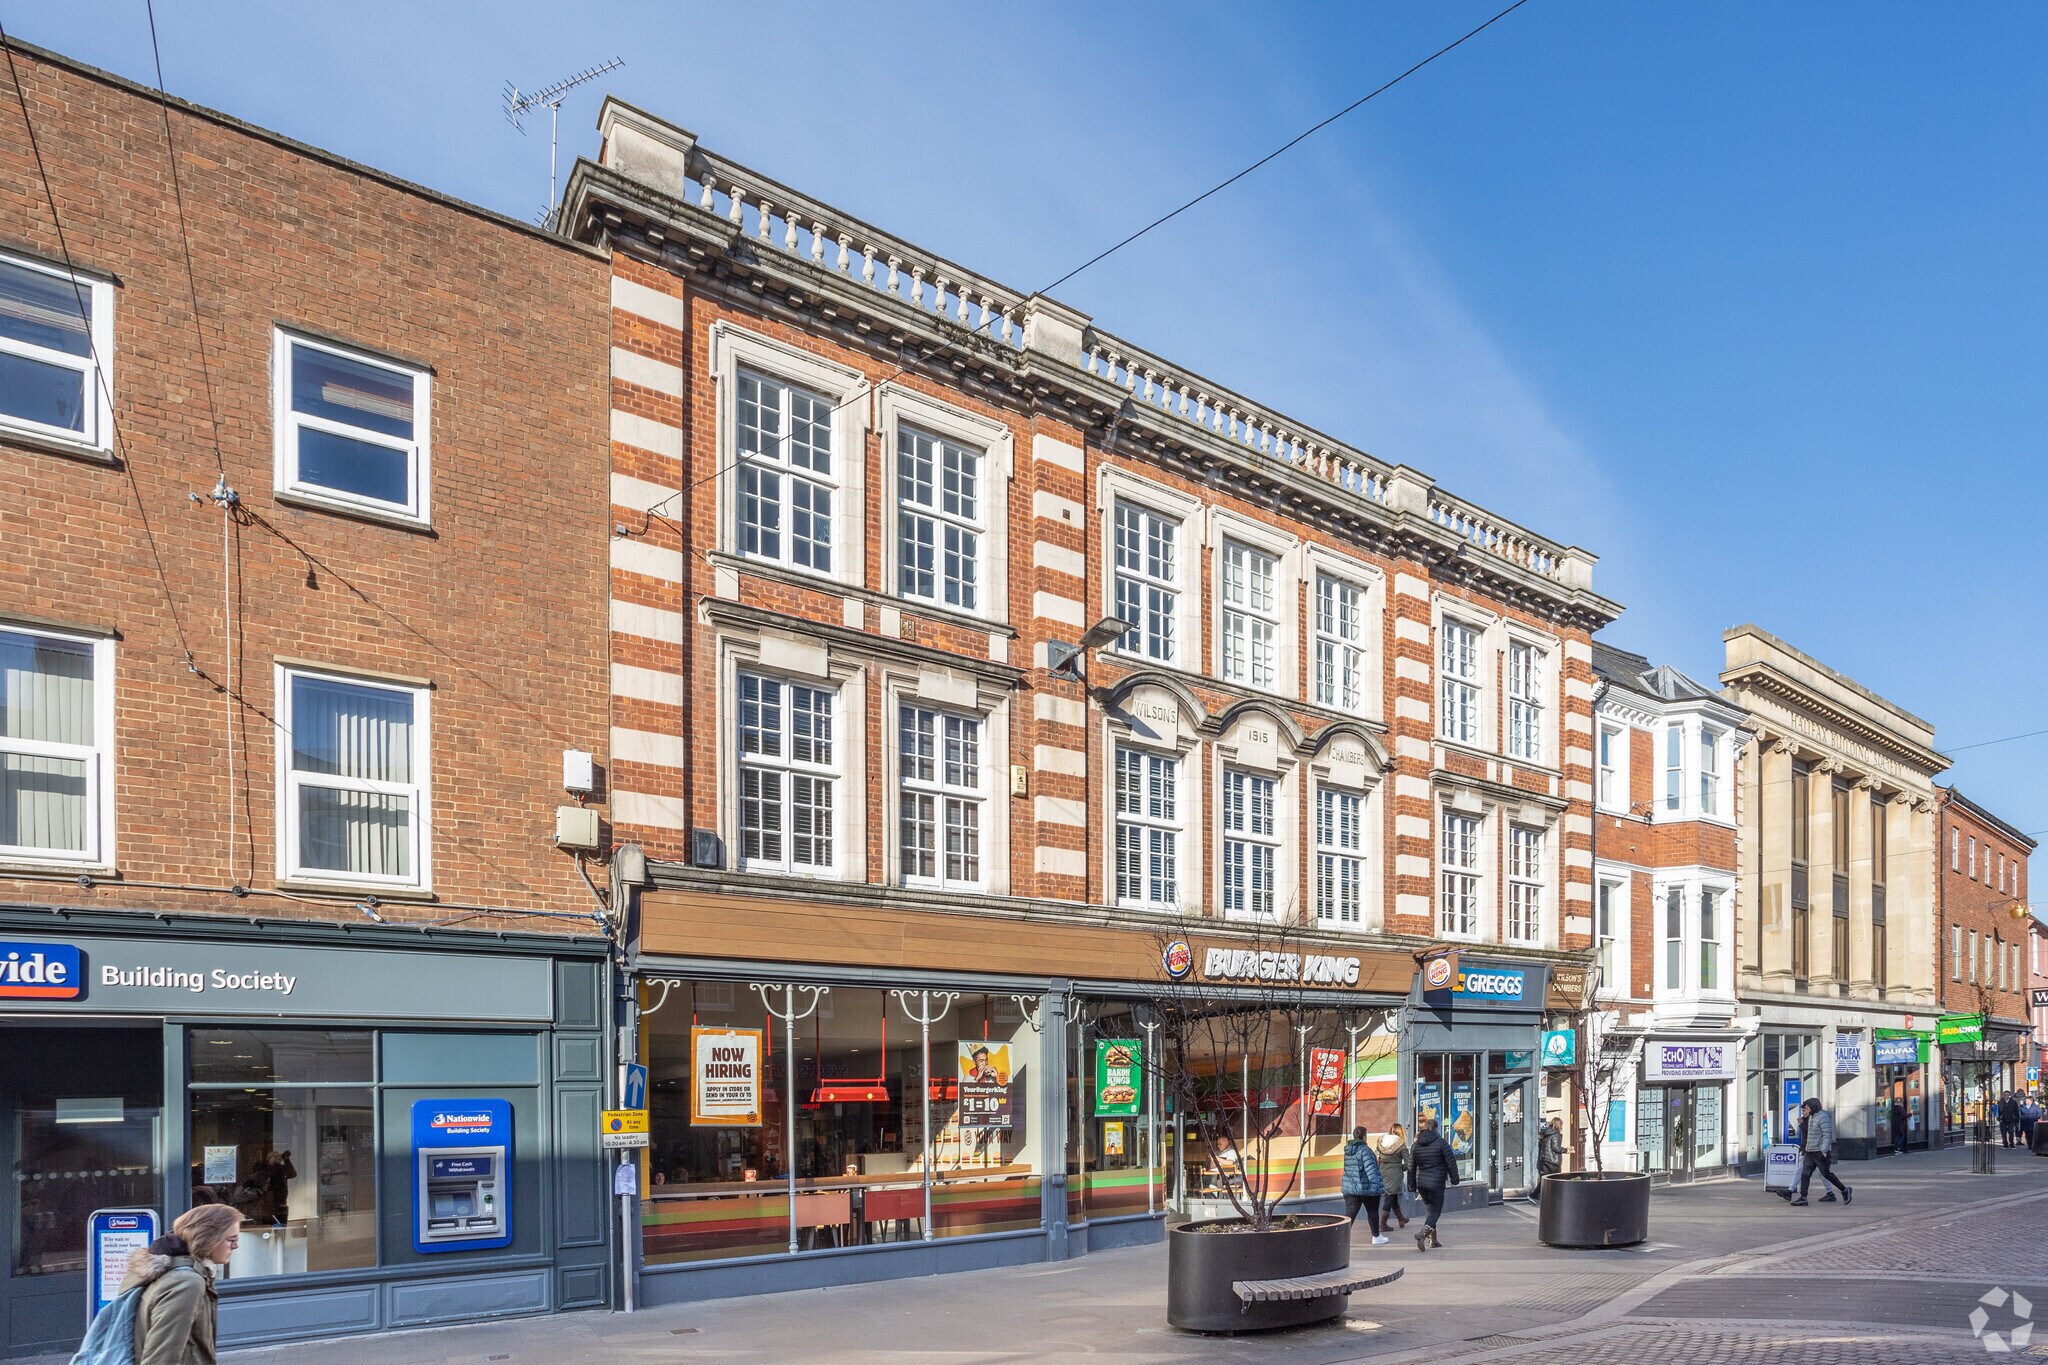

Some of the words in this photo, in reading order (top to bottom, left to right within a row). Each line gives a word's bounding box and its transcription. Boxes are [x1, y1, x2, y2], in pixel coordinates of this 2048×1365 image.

[1134, 701, 1176, 723] WILSON'S
[1249, 730, 1268, 744] 1915
[1791, 712, 1826, 742] HALIFAX
[1832, 731, 1870, 763] BUILDING
[1332, 747, 1365, 766] CHAMBERS
[1204, 948, 1300, 982] BURGER
[1303, 955, 1361, 984] KING
[102, 965, 205, 993] Building
[211, 969, 297, 995] Society
[1466, 973, 1523, 995] GREGGS
[1556, 972, 1582, 983] WILSON'S
[1552, 983, 1582, 993] CHAMBERS
[1942, 1026, 1982, 1035] SUBWAY
[712, 1047, 745, 1062] NOW
[1662, 1048, 1684, 1063] ECHO
[1835, 1047, 1861, 1060] HALIFAX
[1877, 1047, 1915, 1055] HALIFAX
[705, 1063, 752, 1078] HIRING
[446, 1114, 490, 1122] Nationwide
[974, 1130, 993, 1144] YOUR
[996, 1129, 1013, 1144] WAY
[1771, 1153, 1795, 1161] ECHO
